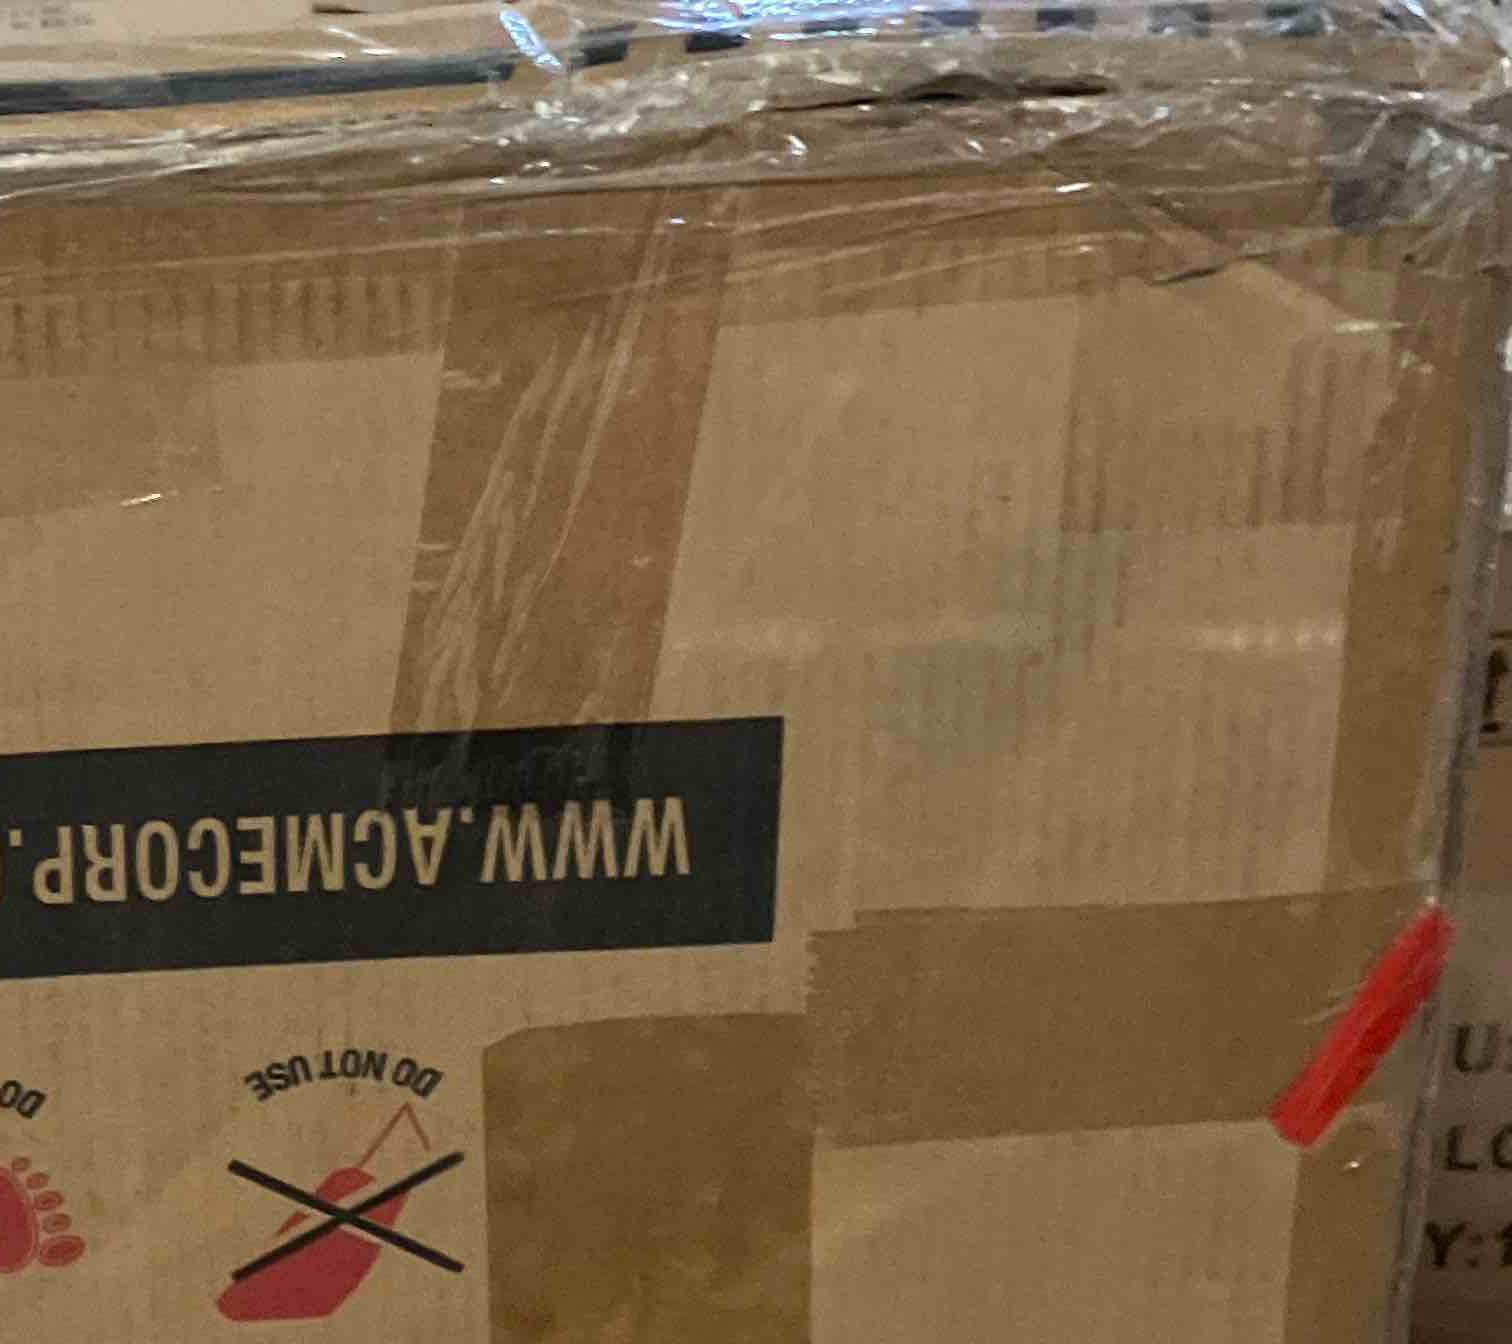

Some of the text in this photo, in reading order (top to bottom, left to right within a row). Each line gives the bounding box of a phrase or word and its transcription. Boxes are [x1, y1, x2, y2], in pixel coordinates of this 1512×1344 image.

[244, 1049, 445, 1102] DO NOT USE
